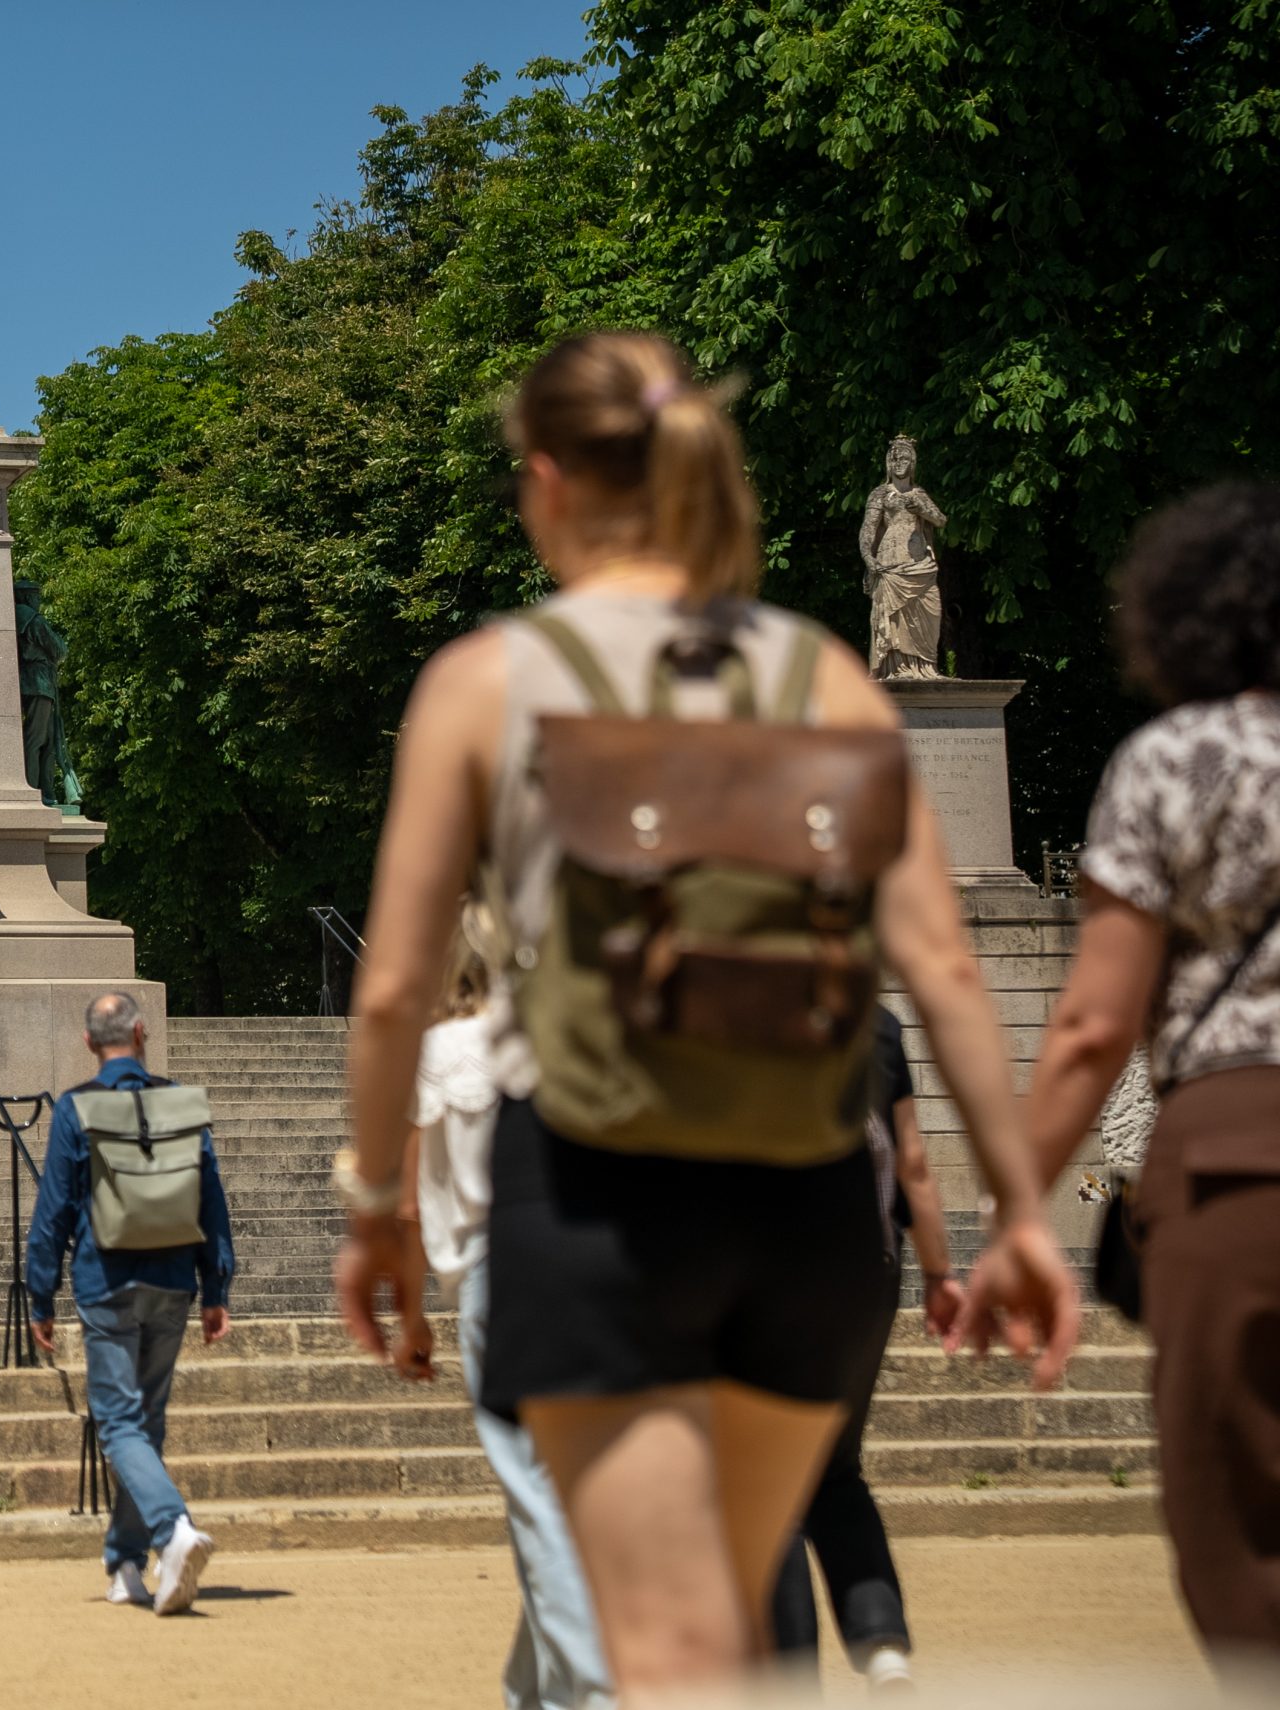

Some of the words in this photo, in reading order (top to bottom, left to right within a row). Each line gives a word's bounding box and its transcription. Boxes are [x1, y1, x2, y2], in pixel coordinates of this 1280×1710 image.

[936, 737, 951, 745] DE
[953, 736, 1005, 746] BRETAGNE
[933, 754, 946, 762] DE
[950, 754, 991, 762] FRANCE
